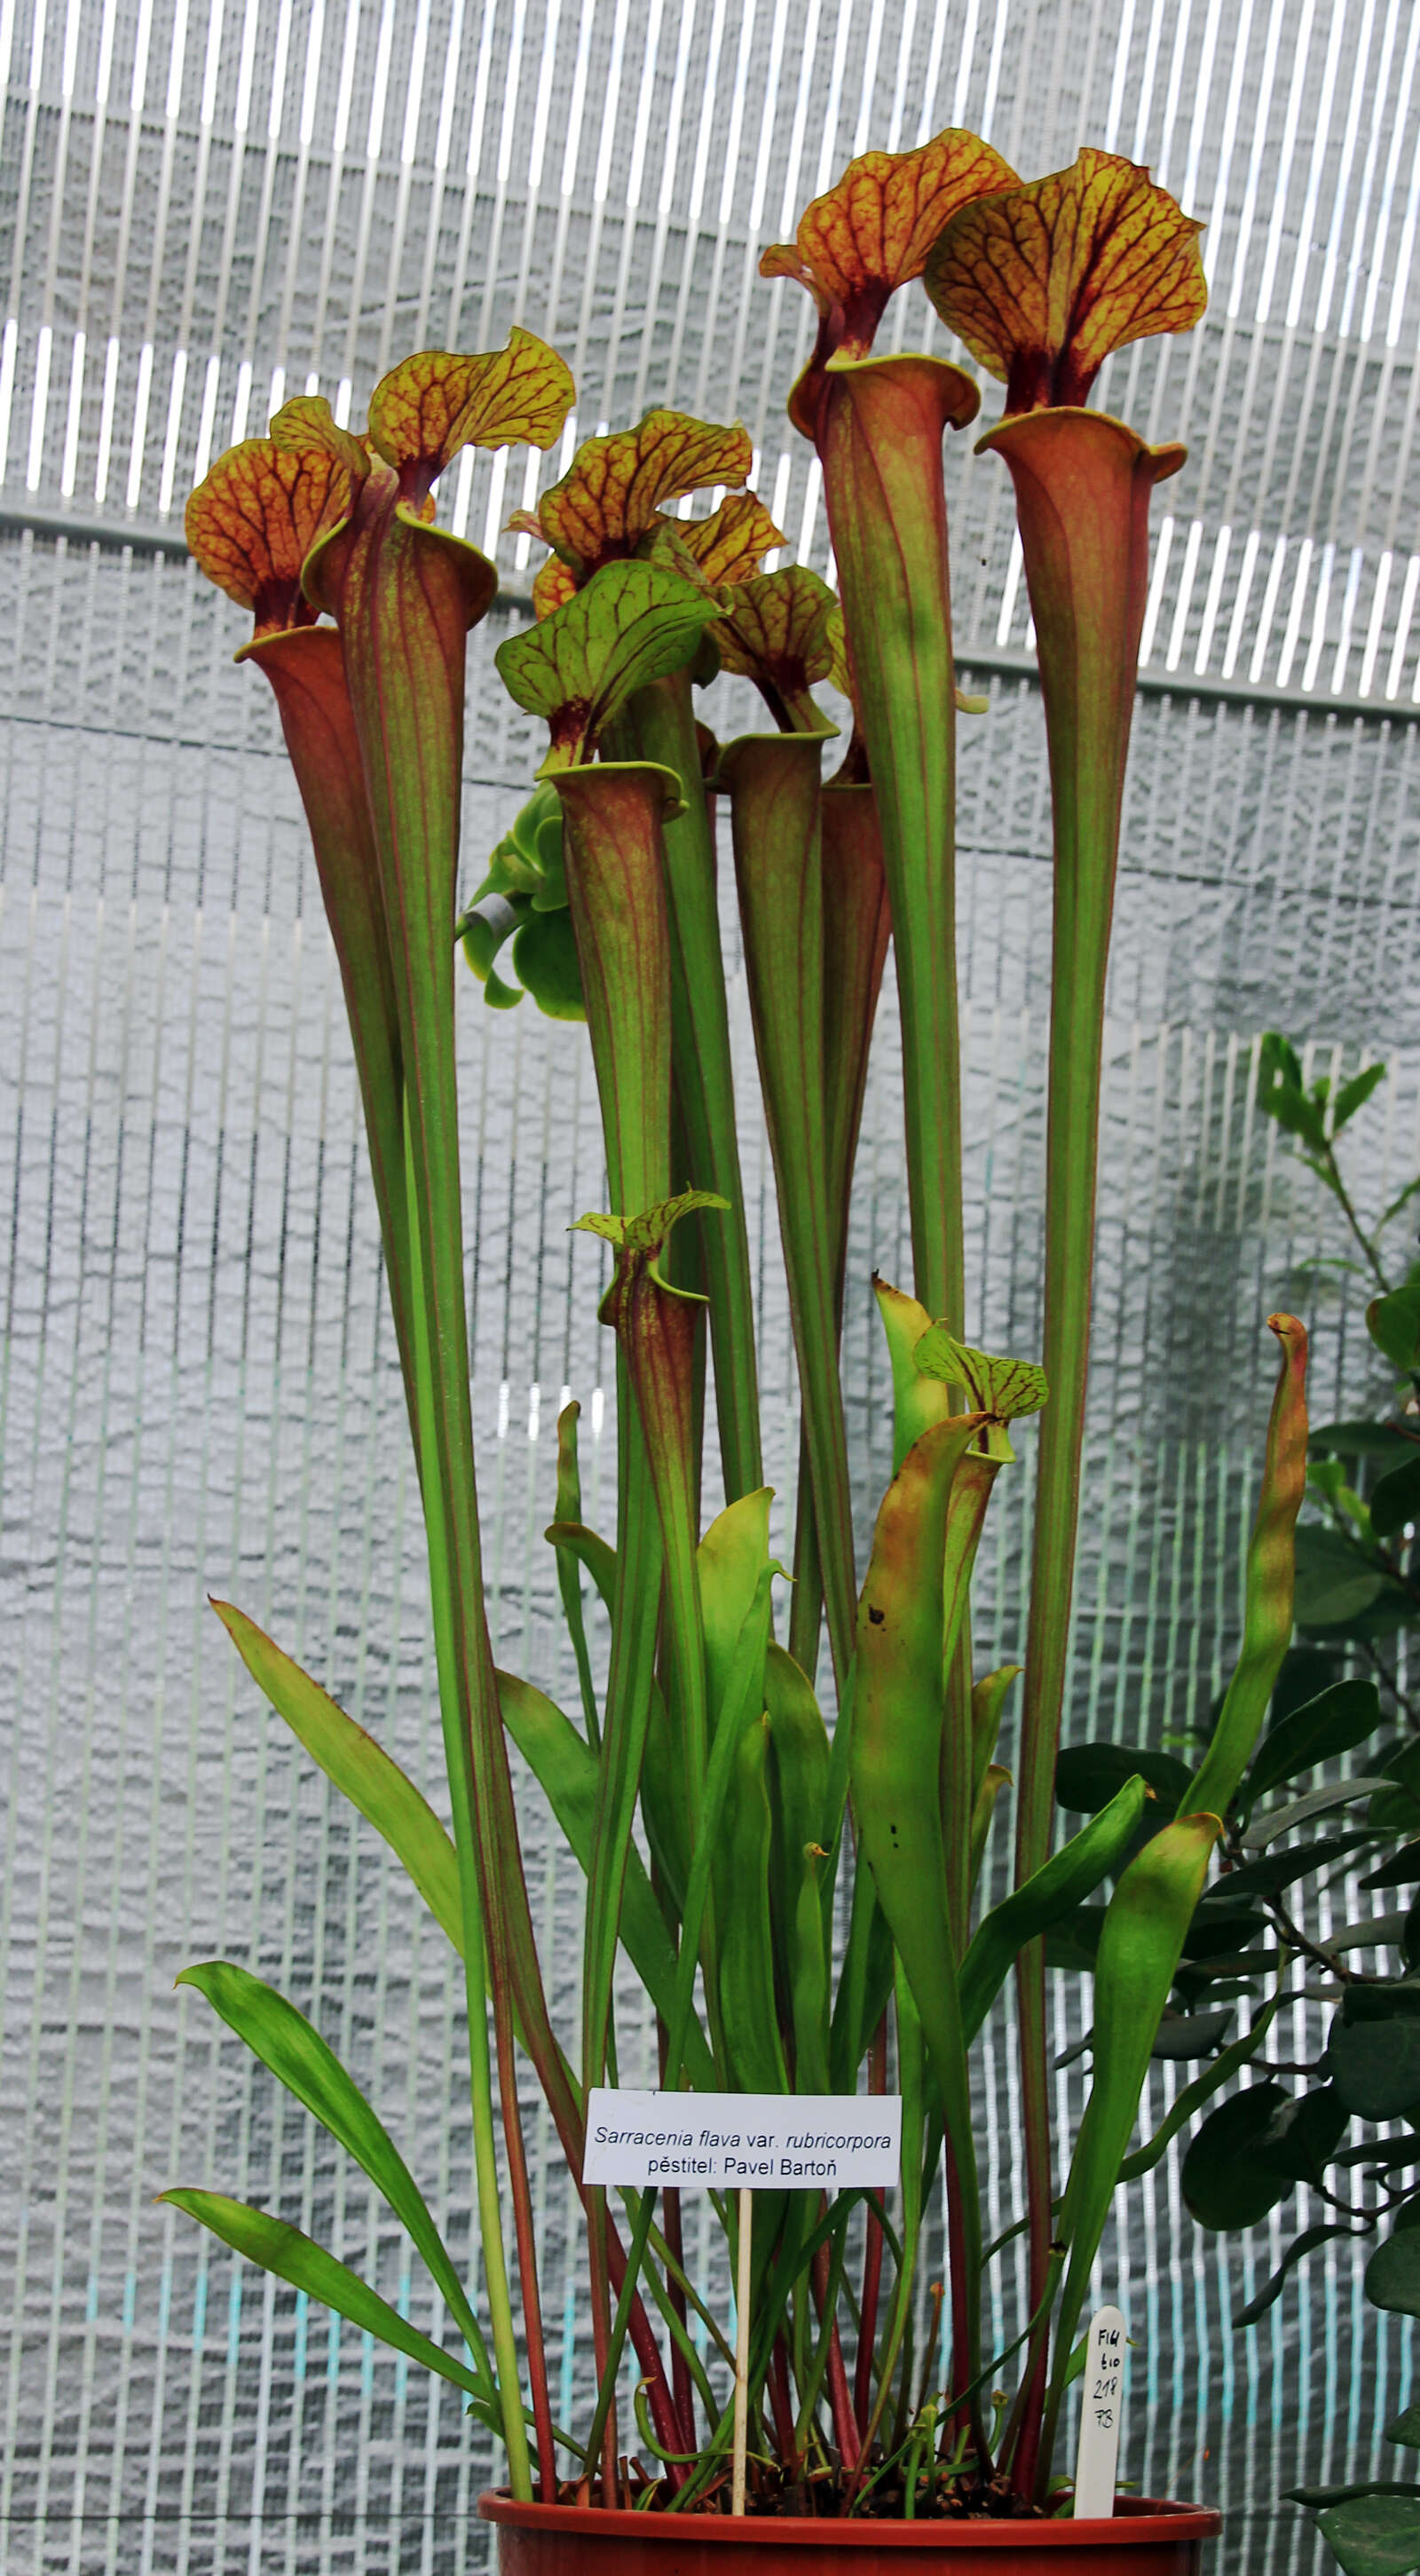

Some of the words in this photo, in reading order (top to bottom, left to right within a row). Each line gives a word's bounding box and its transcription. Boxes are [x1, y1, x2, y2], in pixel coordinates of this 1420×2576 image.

[594, 2126, 693, 2147] Sarracenia
[698, 2130, 741, 2147] flava
[746, 2135, 780, 2149] var.
[785, 2131, 892, 2153] rubricorpora
[647, 2156, 718, 2176] pěstitel:
[723, 2157, 774, 2176] Pavel
[779, 2158, 838, 2177] Bartoň
